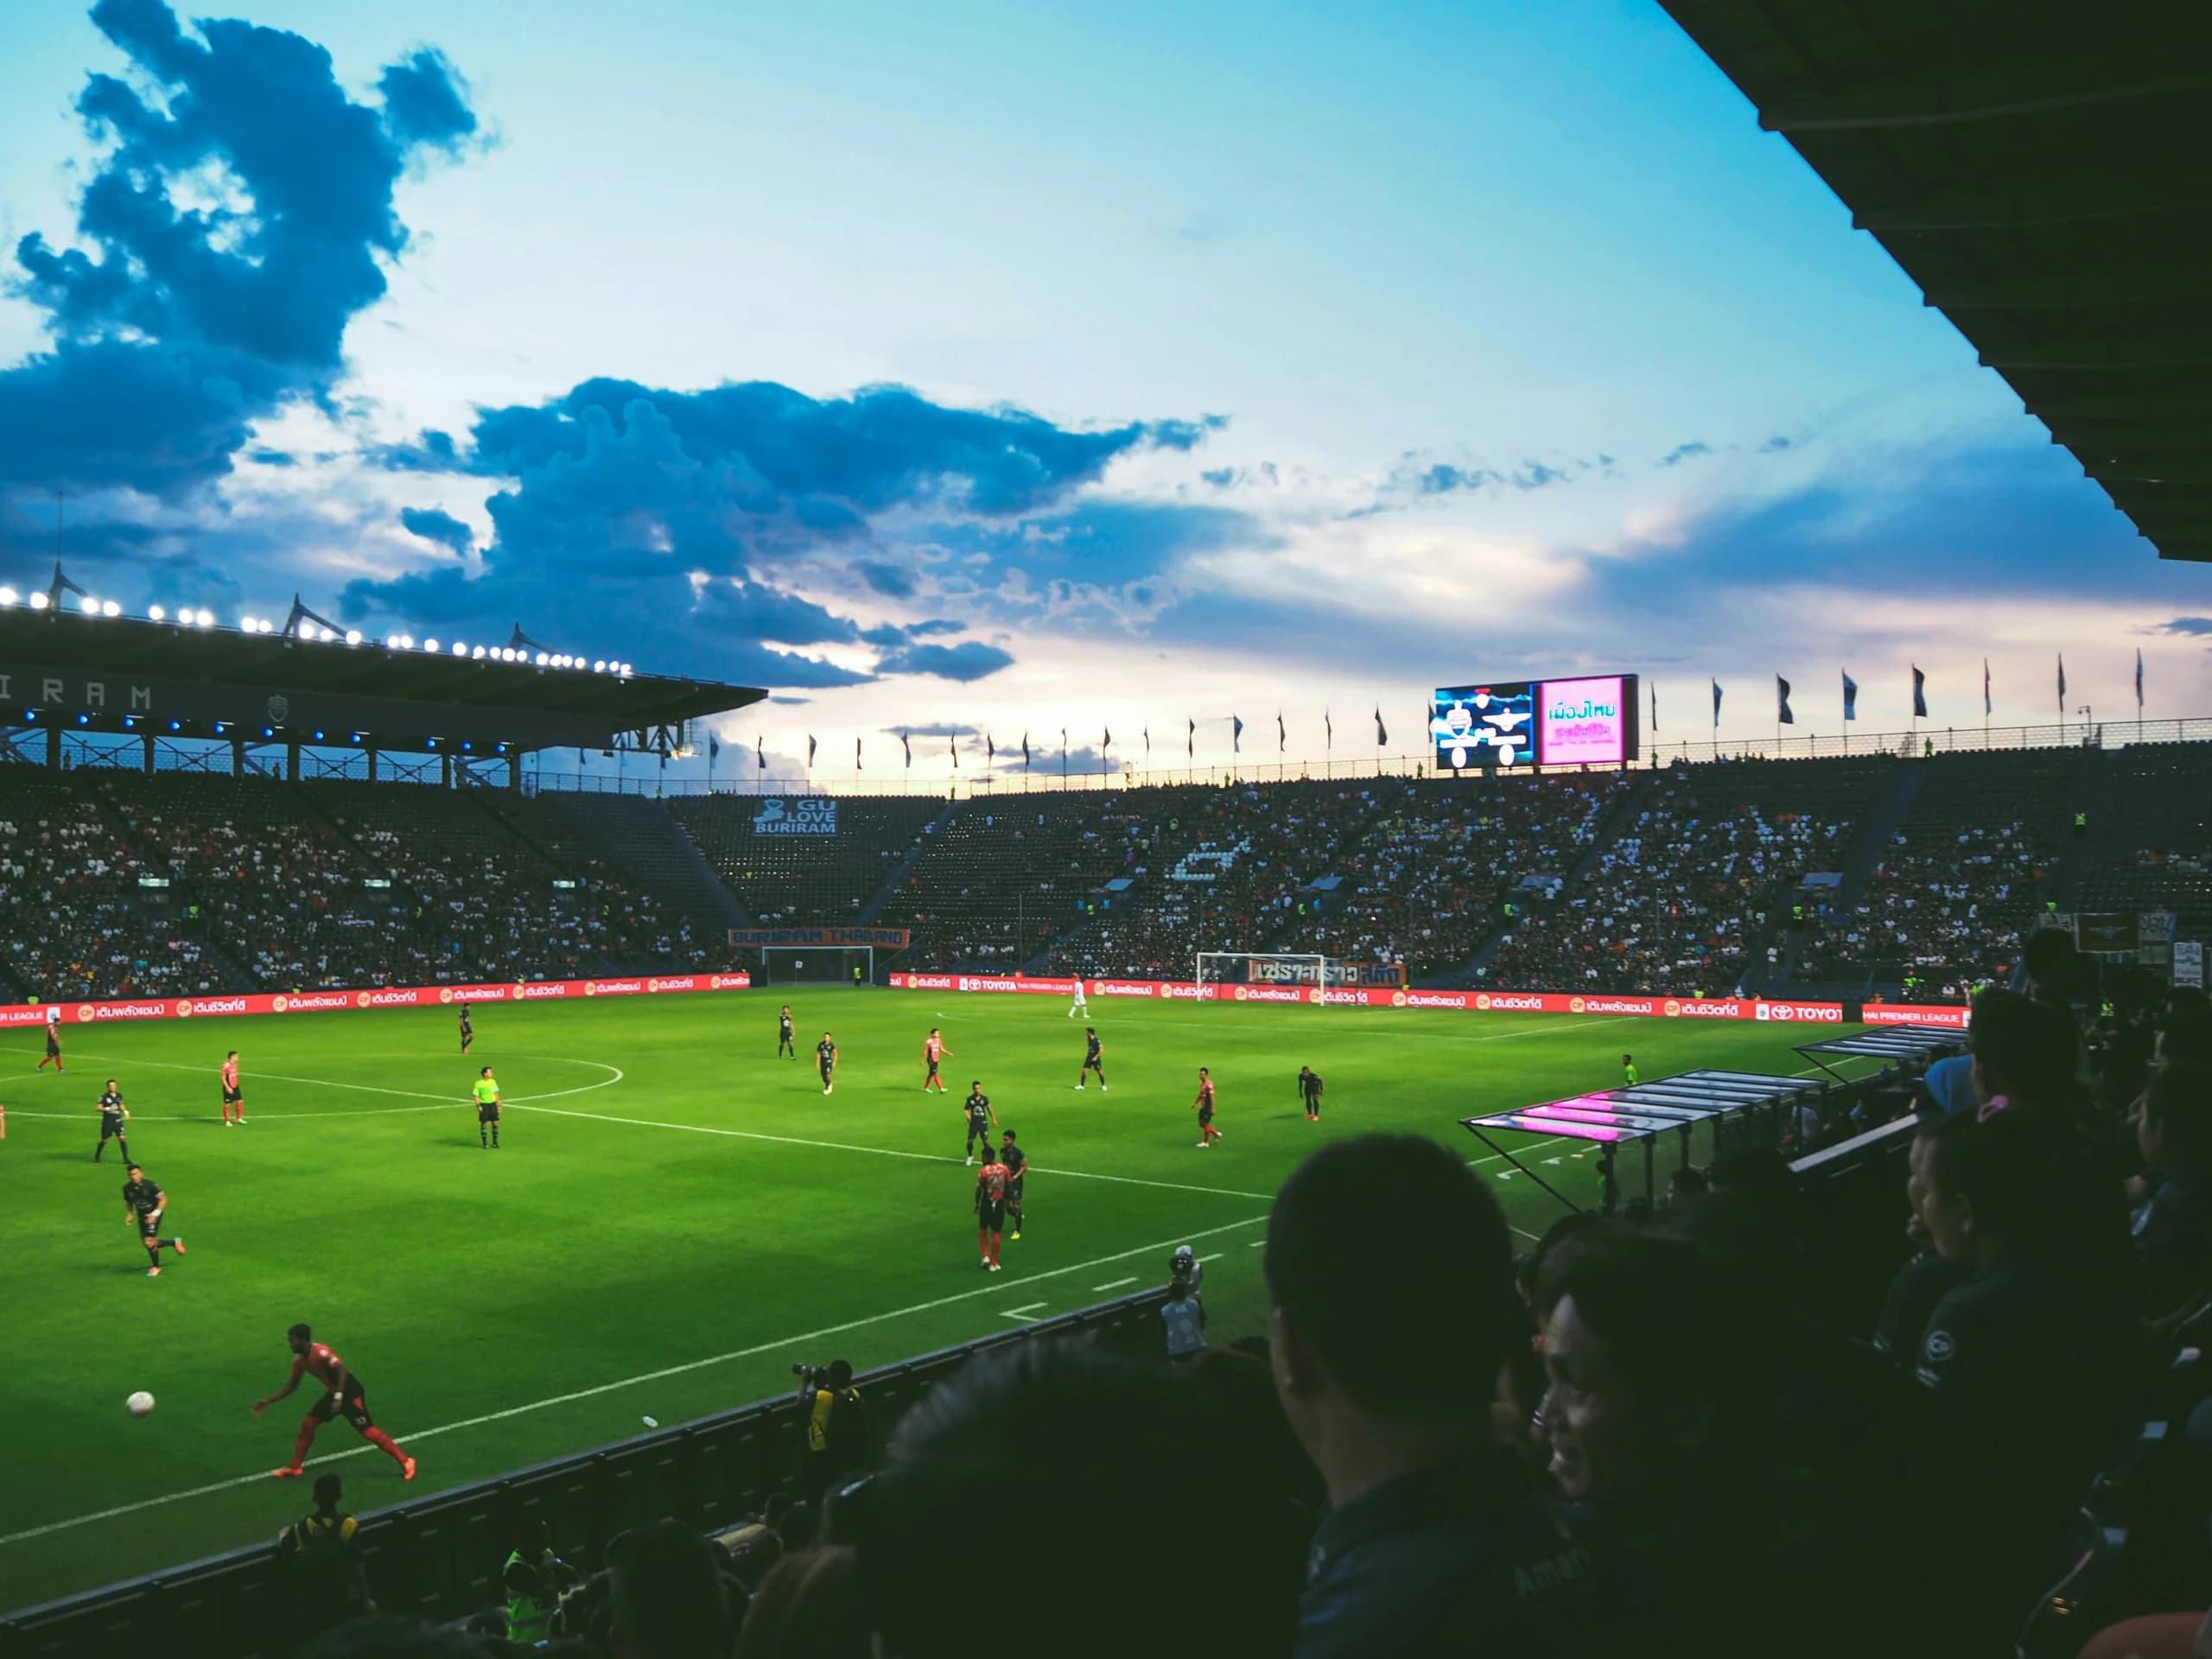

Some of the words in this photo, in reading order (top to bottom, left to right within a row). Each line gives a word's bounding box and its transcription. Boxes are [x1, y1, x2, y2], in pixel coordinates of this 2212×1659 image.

[797, 799, 836, 810] GU
[787, 811, 836, 823] LOVE
[755, 823, 836, 834] BURIRAM
[982, 981, 1017, 991] TOYOTA
[10, 1012, 43, 1020] LEAGUE
[1879, 1012, 1921, 1020] PREMIER
[1922, 1014, 1959, 1023] LEAGUE
